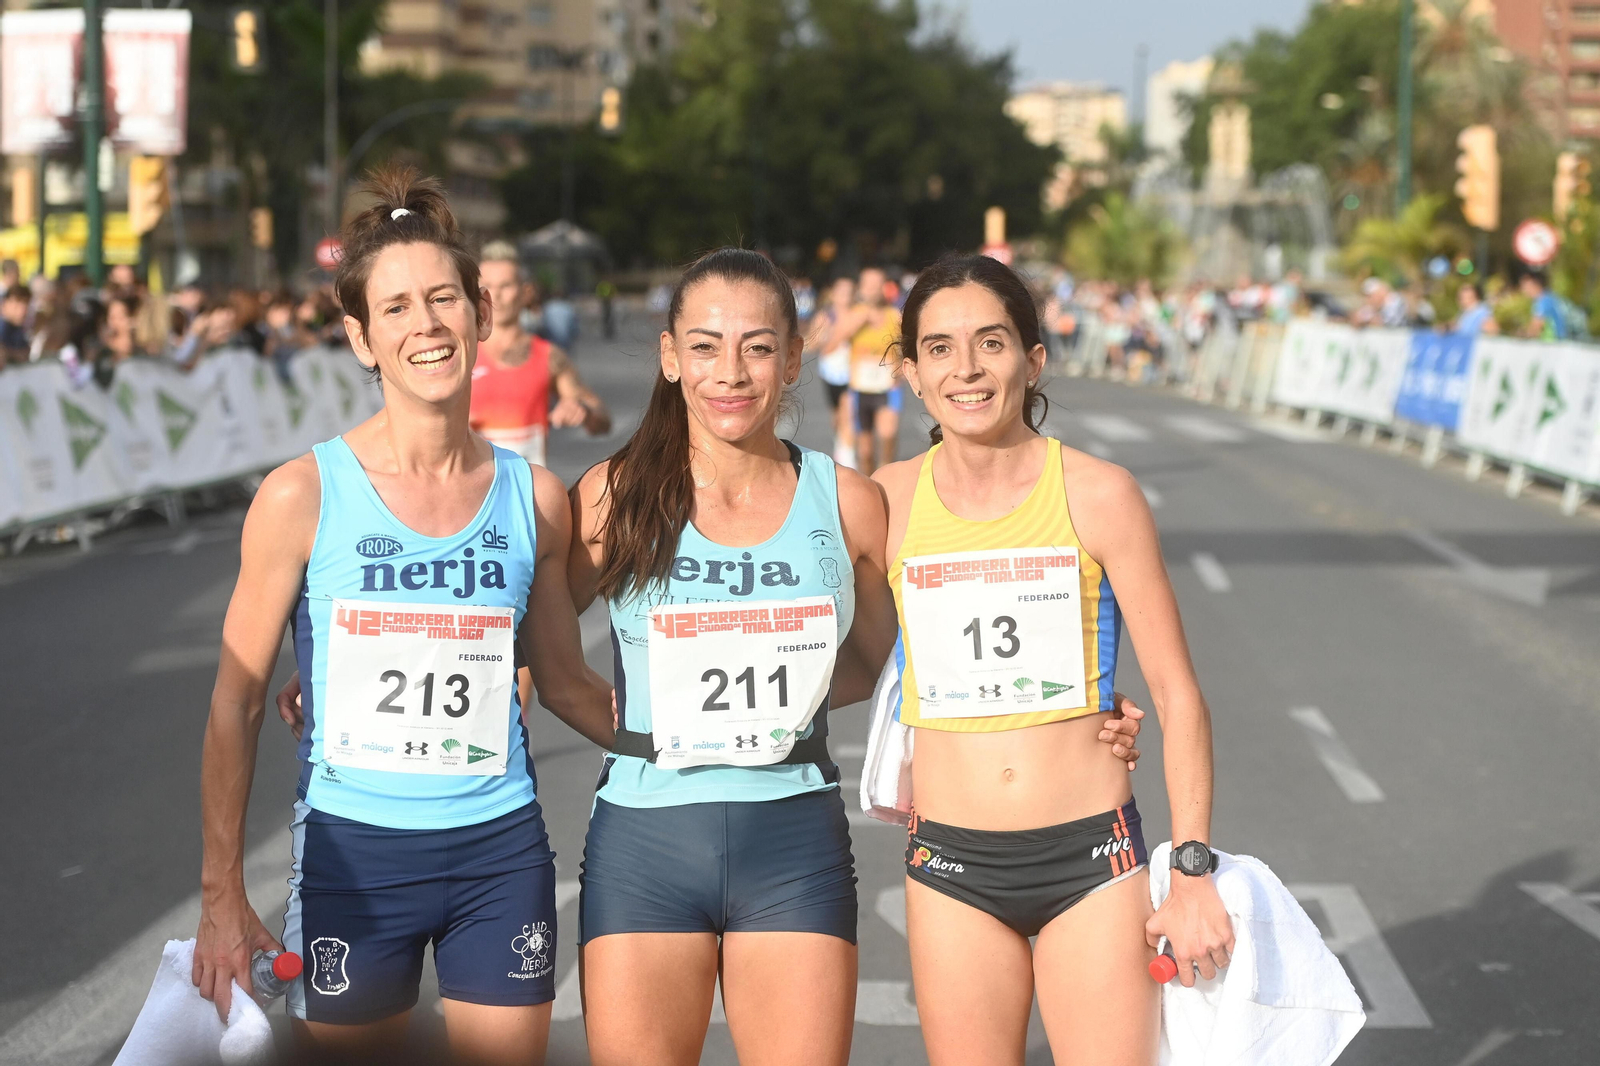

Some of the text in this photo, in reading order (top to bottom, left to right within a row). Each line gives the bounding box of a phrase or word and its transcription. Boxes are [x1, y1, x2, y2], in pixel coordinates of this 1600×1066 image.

[358, 538, 401, 555] TROPS
[360, 547, 507, 599] nerja
[669, 551, 800, 596] erja
[906, 555, 1076, 590] 42 CARRERA URBANA
[943, 573, 976, 582] CIUDAD
[1017, 592, 1069, 602] FEDERADO
[336, 608, 512, 637] 42 CARRERA URBANA
[381, 624, 418, 634] CIUDAD
[653, 612, 697, 639] 42
[697, 608, 769, 625] CARRERA
[773, 604, 833, 620] URBANA
[698, 623, 734, 633] CIUDAD
[963, 615, 1021, 661] 13
[777, 642, 827, 653] FEDERADO
[458, 653, 503, 662] FEDERADO
[376, 669, 470, 718] 213
[700, 664, 788, 712] 211
[927, 856, 965, 874] Álora
[522, 921, 548, 937] CMD
[521, 956, 549, 972] NERJA
